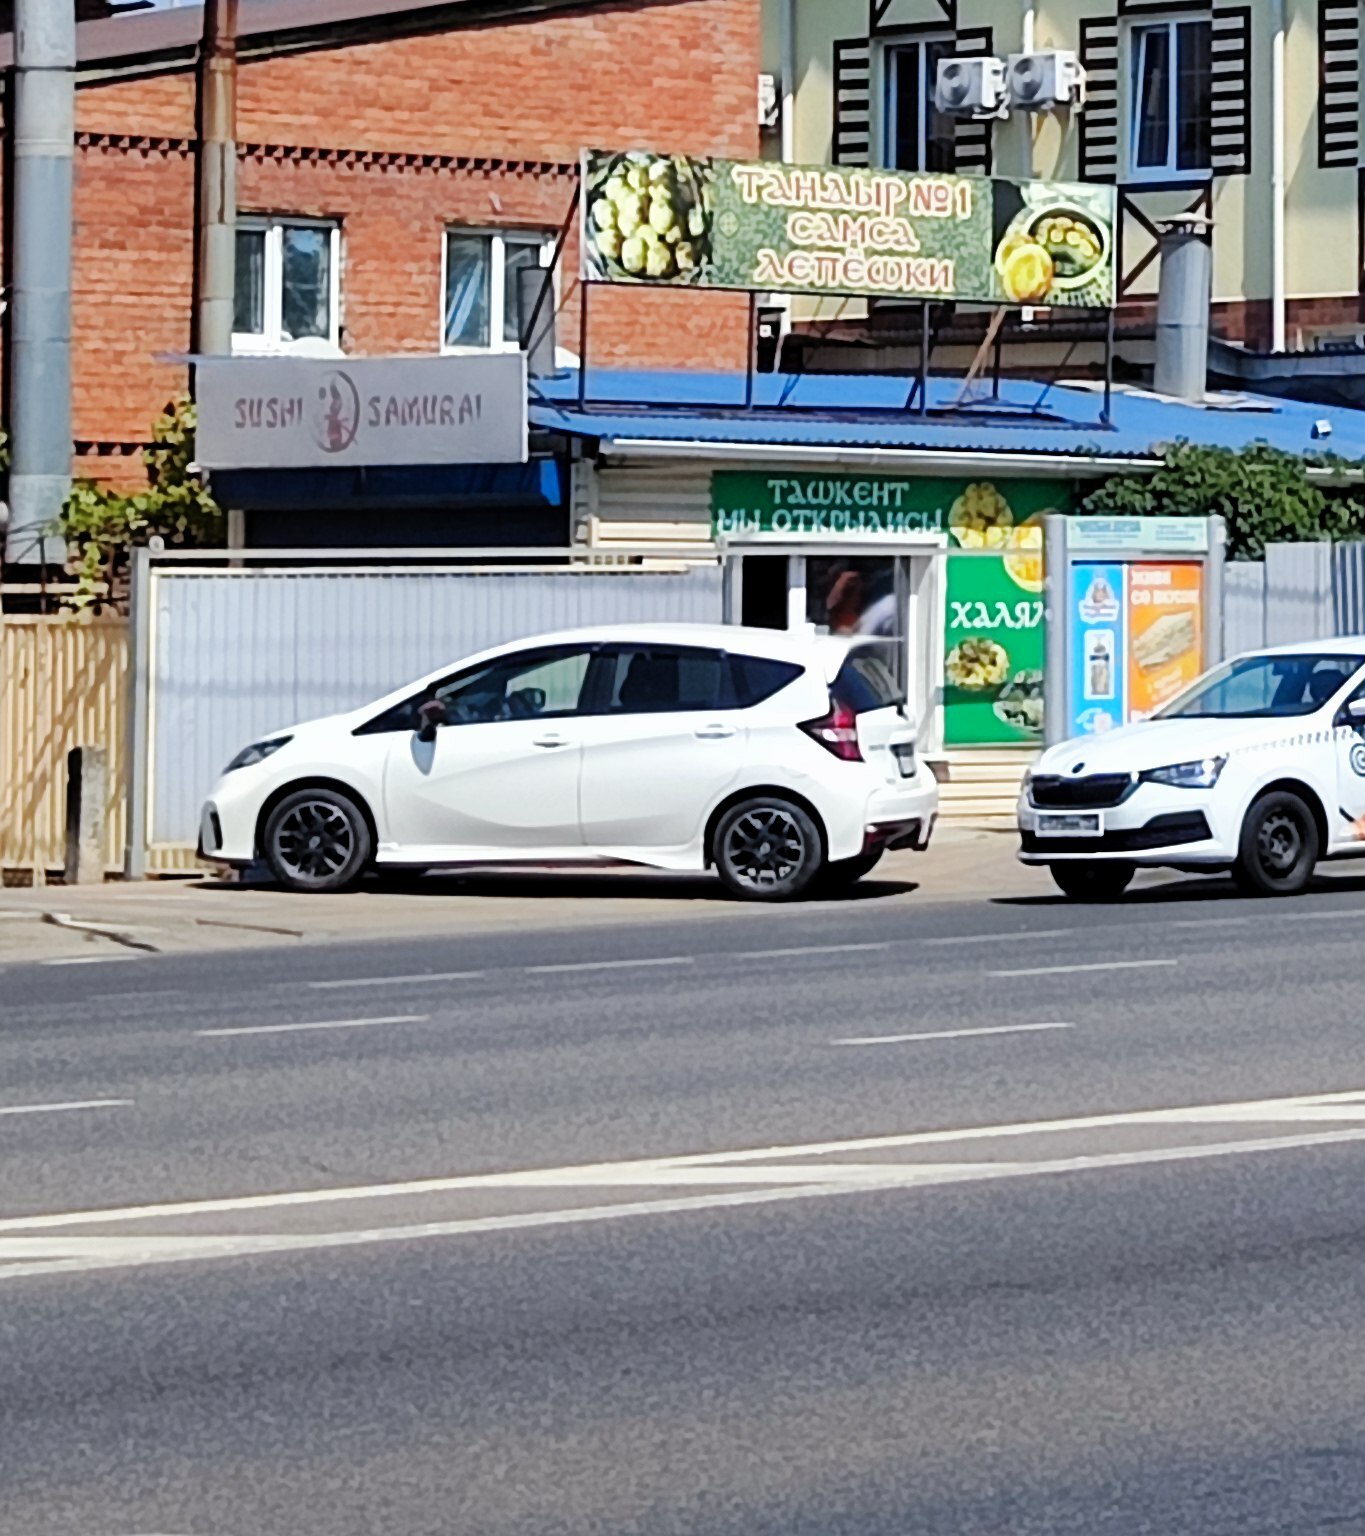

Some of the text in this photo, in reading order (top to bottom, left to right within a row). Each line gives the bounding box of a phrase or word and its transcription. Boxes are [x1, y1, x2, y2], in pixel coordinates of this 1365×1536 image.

[734, 166, 906, 217] ТАНДЫР
[788, 213, 920, 252] САМСА
[234, 394, 483, 429] SUSHI SAMURAI
[767, 478, 910, 508] ТАШКЕНТ
